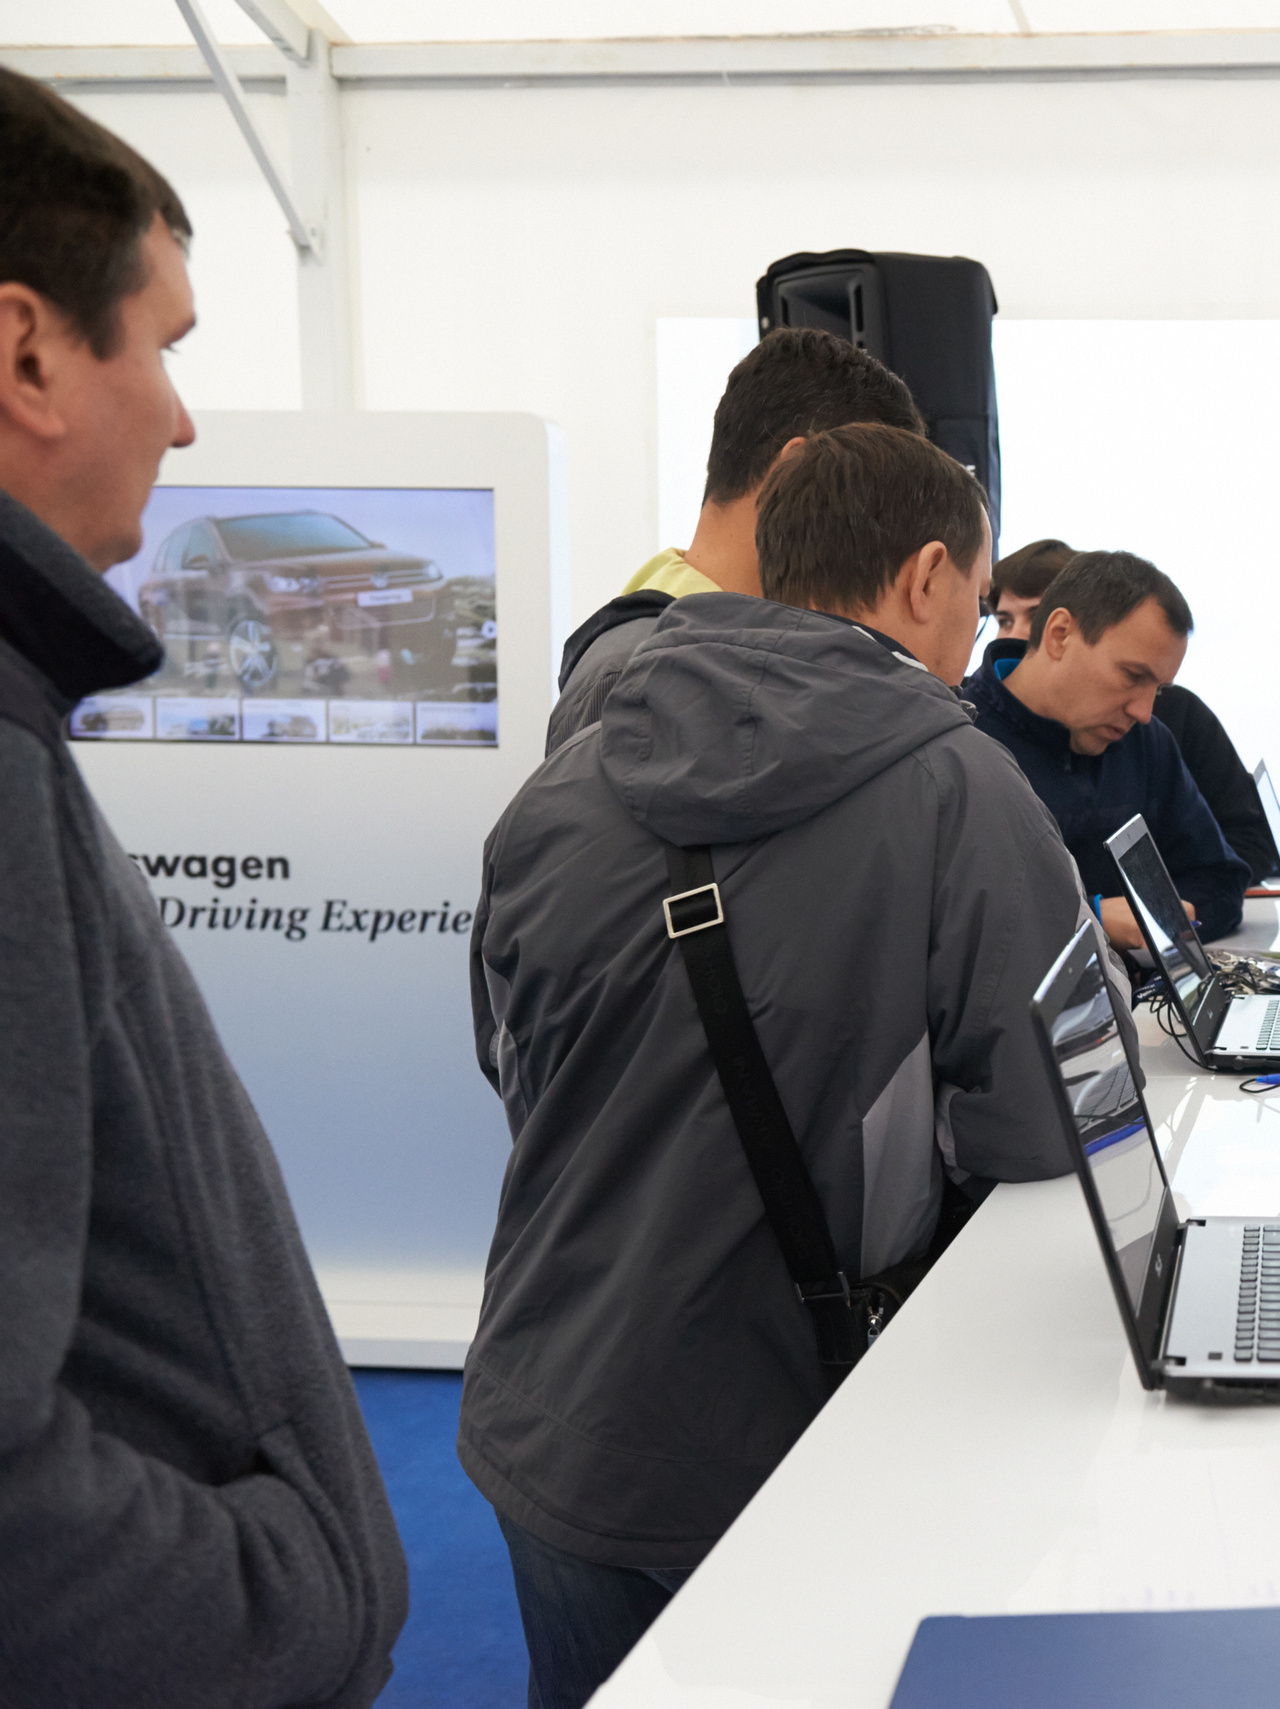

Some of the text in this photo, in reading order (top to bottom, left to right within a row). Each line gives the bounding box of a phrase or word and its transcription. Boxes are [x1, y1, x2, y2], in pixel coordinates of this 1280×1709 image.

[127, 854, 290, 889] wagen
[159, 896, 473, 942] Driving Experie
